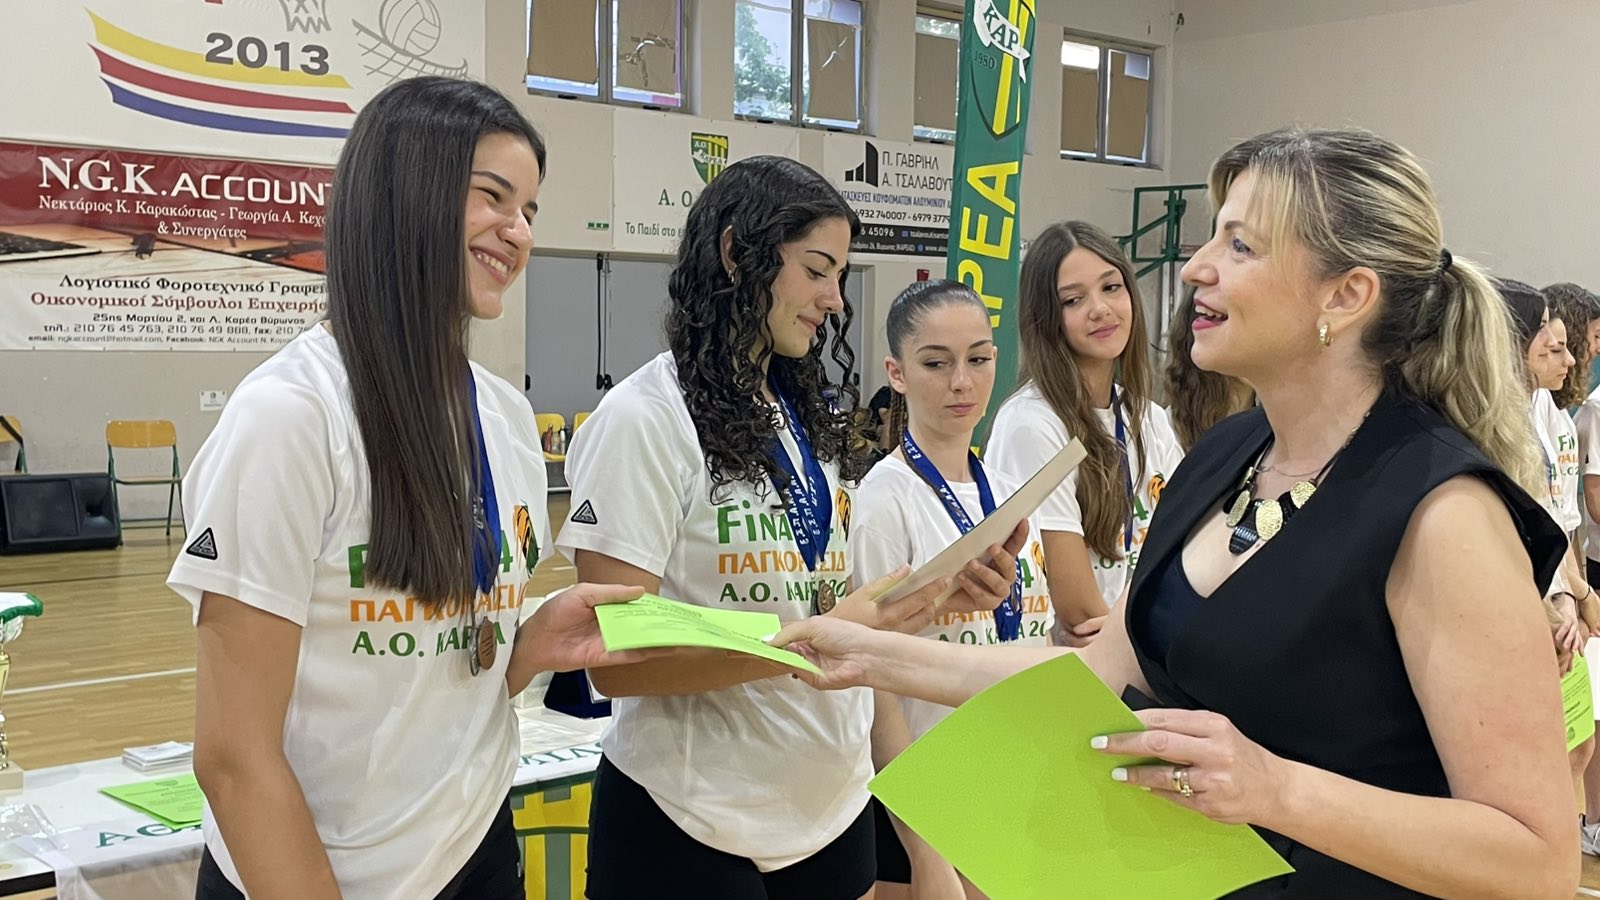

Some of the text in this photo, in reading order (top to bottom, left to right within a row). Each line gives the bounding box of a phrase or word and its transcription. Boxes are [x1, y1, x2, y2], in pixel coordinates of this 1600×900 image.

[205, 32, 330, 76] 2013
[882, 151, 939, 171] Π. ΓΑΒΡΙΗΛ
[881, 172, 892, 187] Α.
[658, 188, 675, 207] Α.
[39, 195, 113, 214] Νεκτάριος
[116, 199, 131, 213] Κ.
[135, 201, 218, 221] Καρακώστας
[229, 207, 280, 224] Γεωργία
[282, 210, 295, 223] Α.
[876, 210, 906, 220] 740007
[912, 212, 932, 222] 6979
[157, 221, 247, 241] & Συνεργάτες
[625, 222, 636, 235] Το
[637, 223, 660, 237] Παιδί
[661, 227, 676, 237] στο
[868, 226, 895, 237] 45096
[59, 274, 150, 291] Λογιστικό
[156, 278, 265, 295] Φοροτεχνικό
[31, 292, 146, 309] Οικονομικοί
[151, 295, 243, 311] Σύμβουλοι
[74, 323, 95, 333] 210
[100, 324, 115, 333] 76
[167, 325, 187, 334] 210
[190, 325, 204, 334] 76
[275, 327, 294, 335] 210
[716, 499, 794, 544] FiNA
[719, 582, 779, 602] Α.Ο.
[352, 630, 425, 658] Α.Ο.
